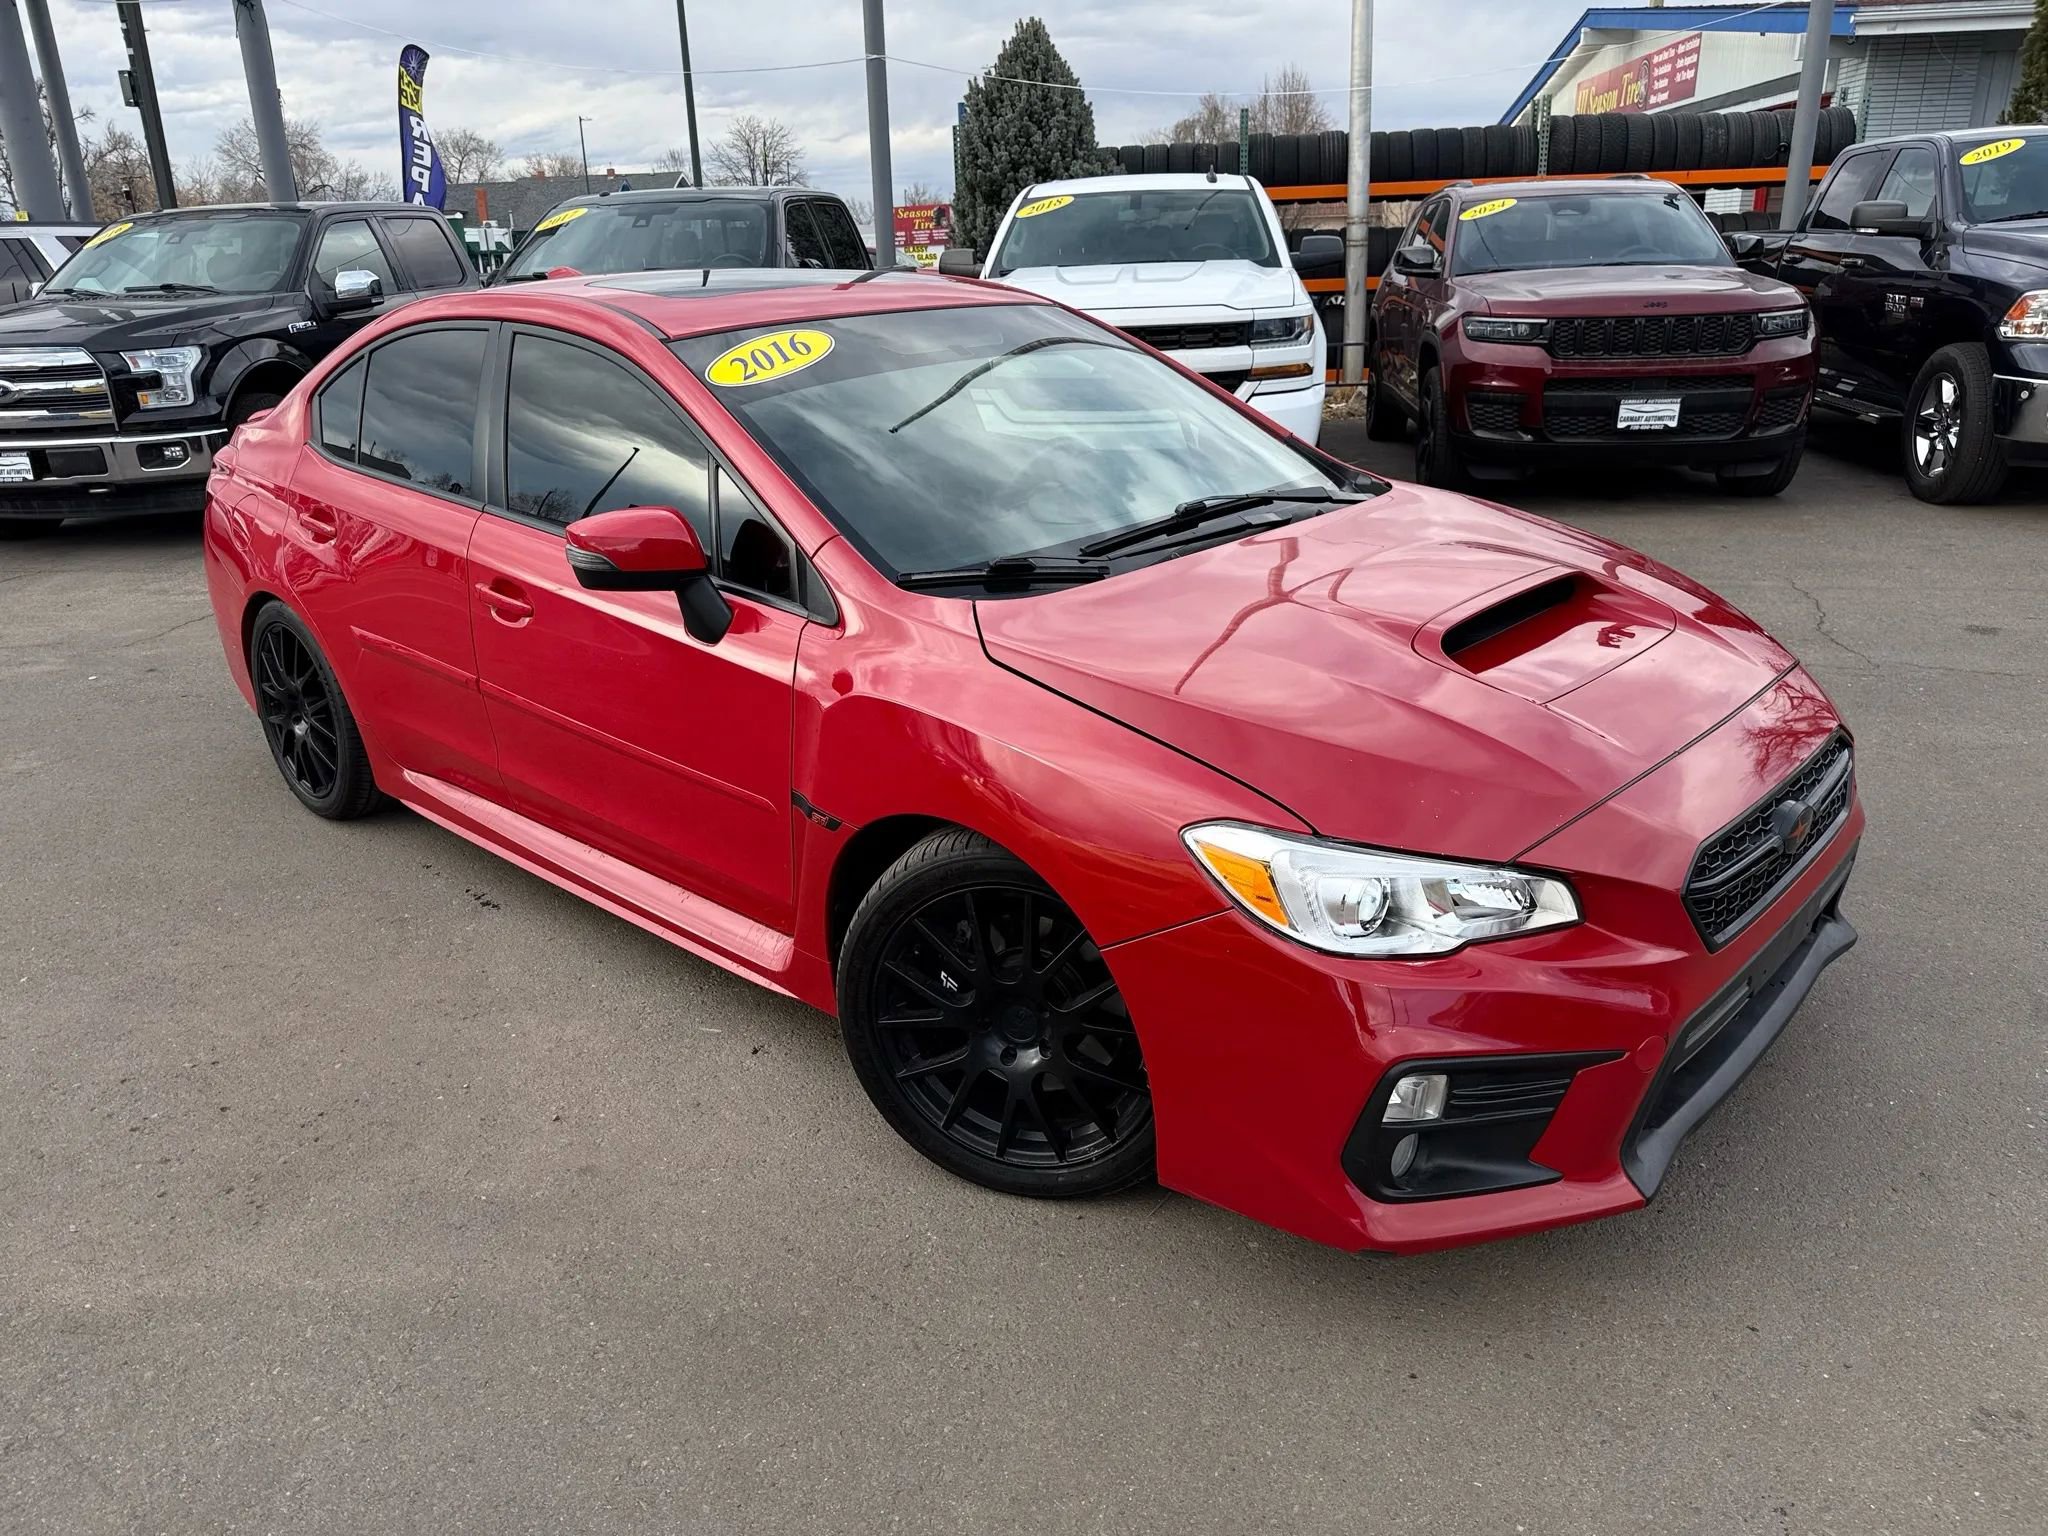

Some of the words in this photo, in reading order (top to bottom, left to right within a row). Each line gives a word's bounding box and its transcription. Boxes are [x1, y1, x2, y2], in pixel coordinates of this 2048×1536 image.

[1588, 86, 1618, 114] Season
[1972, 141, 2012, 162] 2019
[1026, 198, 1064, 216] 2018
[1470, 200, 1506, 218] 2024
[897, 208, 935, 219] Season
[913, 219, 935, 230] Tire
[917, 253, 938, 261] GLASS
[1886, 293, 1907, 304] RAM
[729, 333, 812, 381] 2016
[1619, 415, 1644, 423] CARMART
[1643, 414, 1676, 423] AUTOMOTIVE
[6, 468, 32, 476] AUTOMOTIVE
